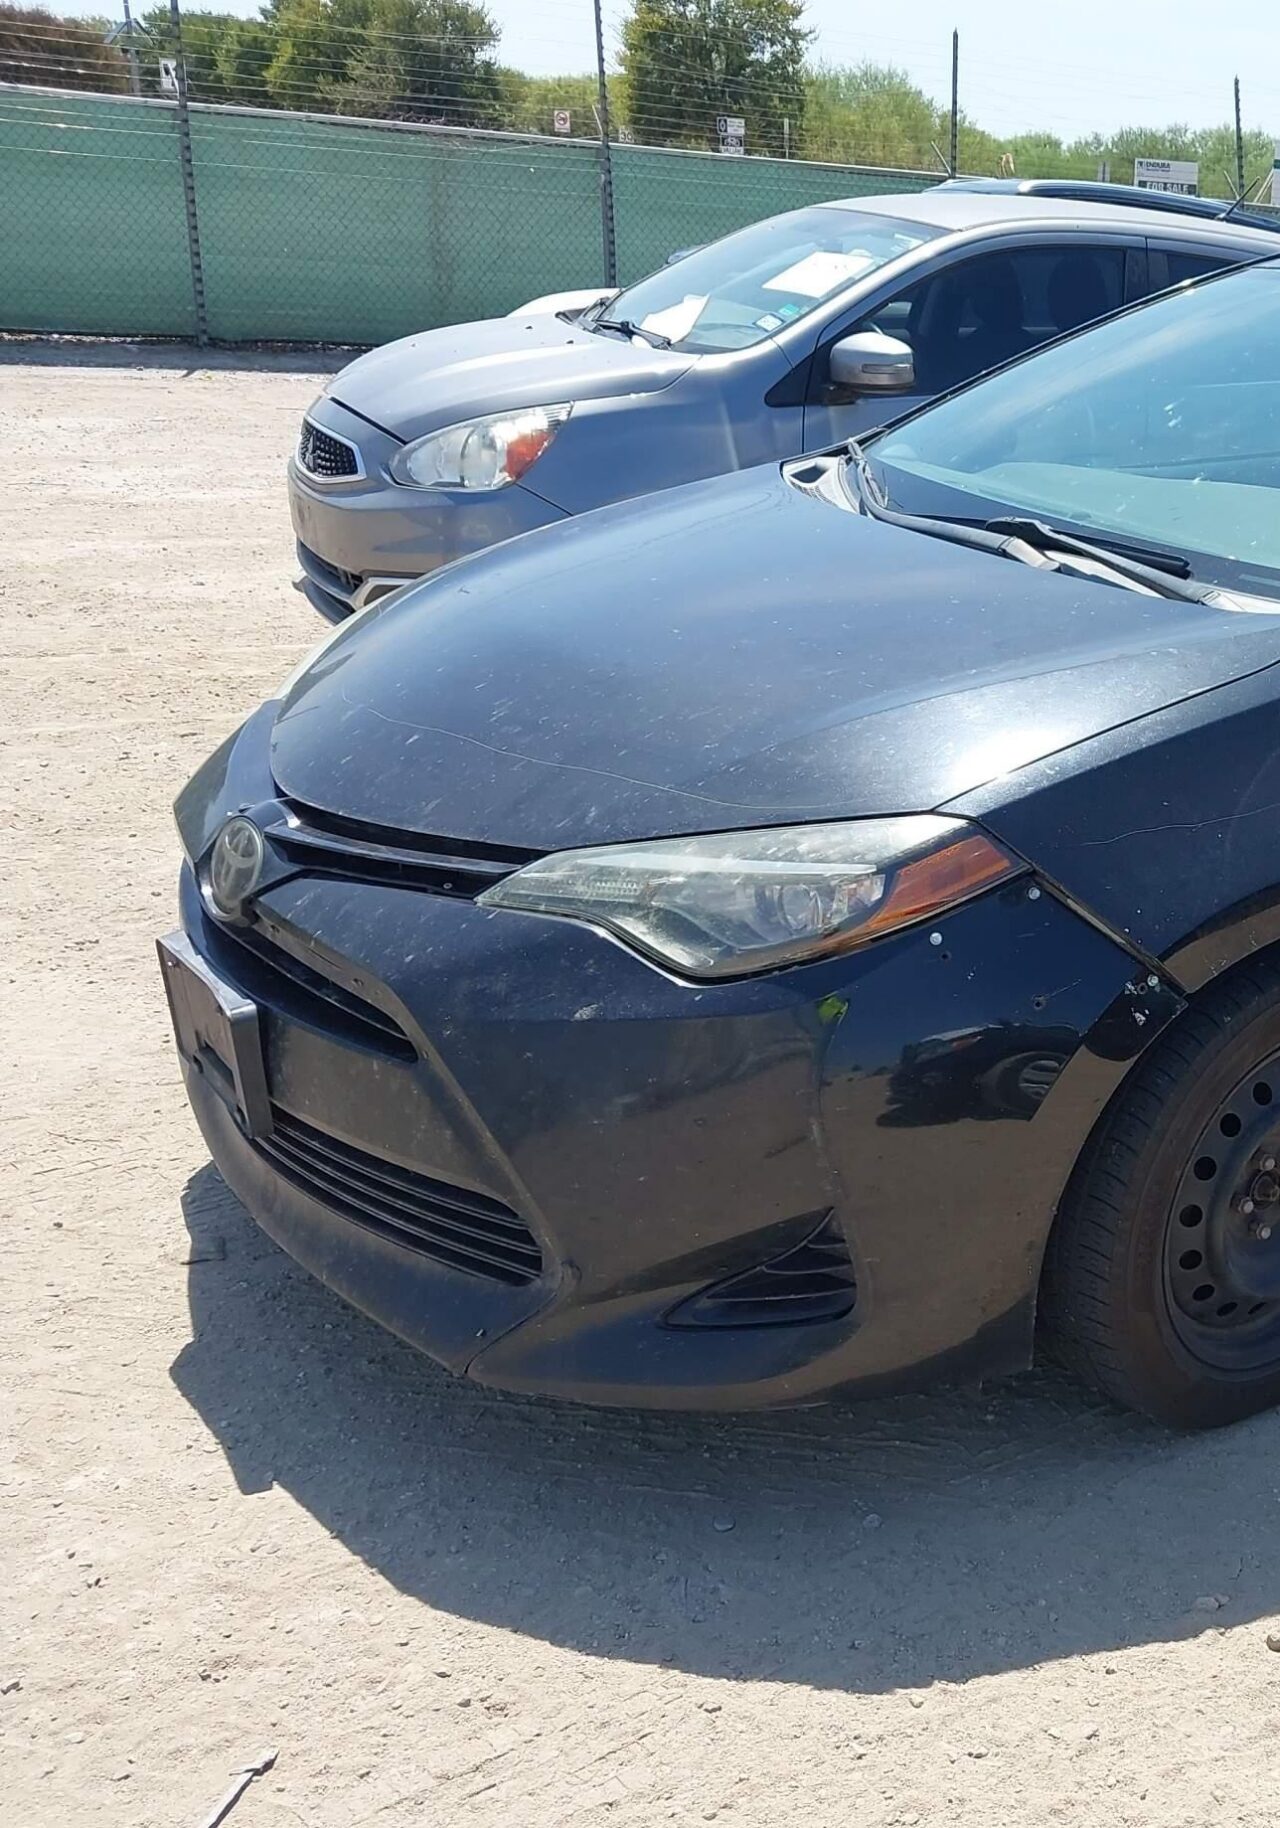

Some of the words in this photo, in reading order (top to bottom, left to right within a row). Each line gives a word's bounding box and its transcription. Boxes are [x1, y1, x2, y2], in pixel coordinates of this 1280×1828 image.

[1146, 160, 1170, 169] ENDURA
[1146, 181, 1164, 192] FOR
[1166, 183, 1189, 195] SALE
